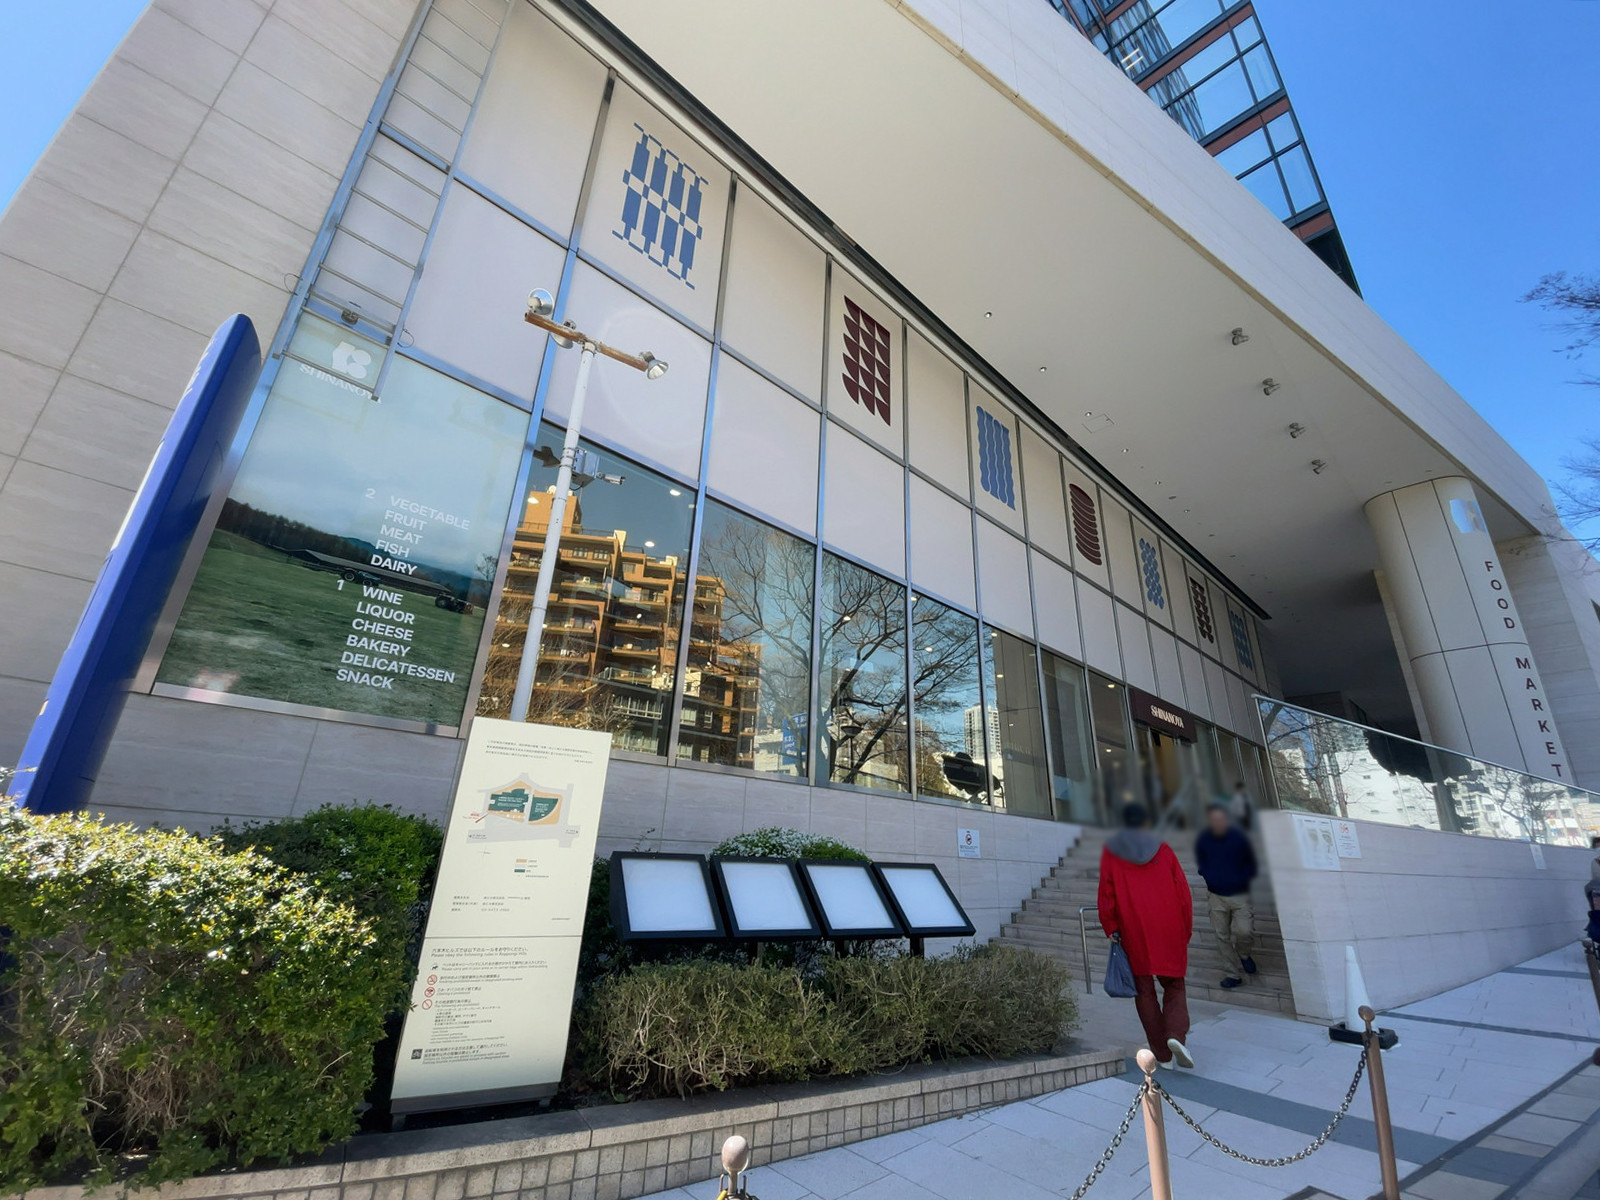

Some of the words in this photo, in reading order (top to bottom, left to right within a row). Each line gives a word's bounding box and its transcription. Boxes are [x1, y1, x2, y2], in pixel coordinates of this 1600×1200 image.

[299, 363, 382, 403] SHINANOY
[365, 487, 376, 499] 2
[390, 495, 471, 530] VEGETABLE
[384, 509, 427, 531] FRUIT
[380, 524, 423, 545] MEAT
[375, 539, 410, 558] FISH
[370, 554, 418, 576] DAIRY
[336, 579, 345, 591] 1
[362, 585, 404, 606] WINE
[356, 601, 416, 625] LIQUOR
[351, 618, 415, 641] CHEESE
[346, 634, 411, 657] BAKERY
[335, 668, 395, 690] SNACK
[340, 651, 456, 684] DELICATESSEN
[1484, 561, 1516, 629] FOOD
[1515, 657, 1562, 778] MARKET
[1150, 704, 1185, 729] SHINANOYA
